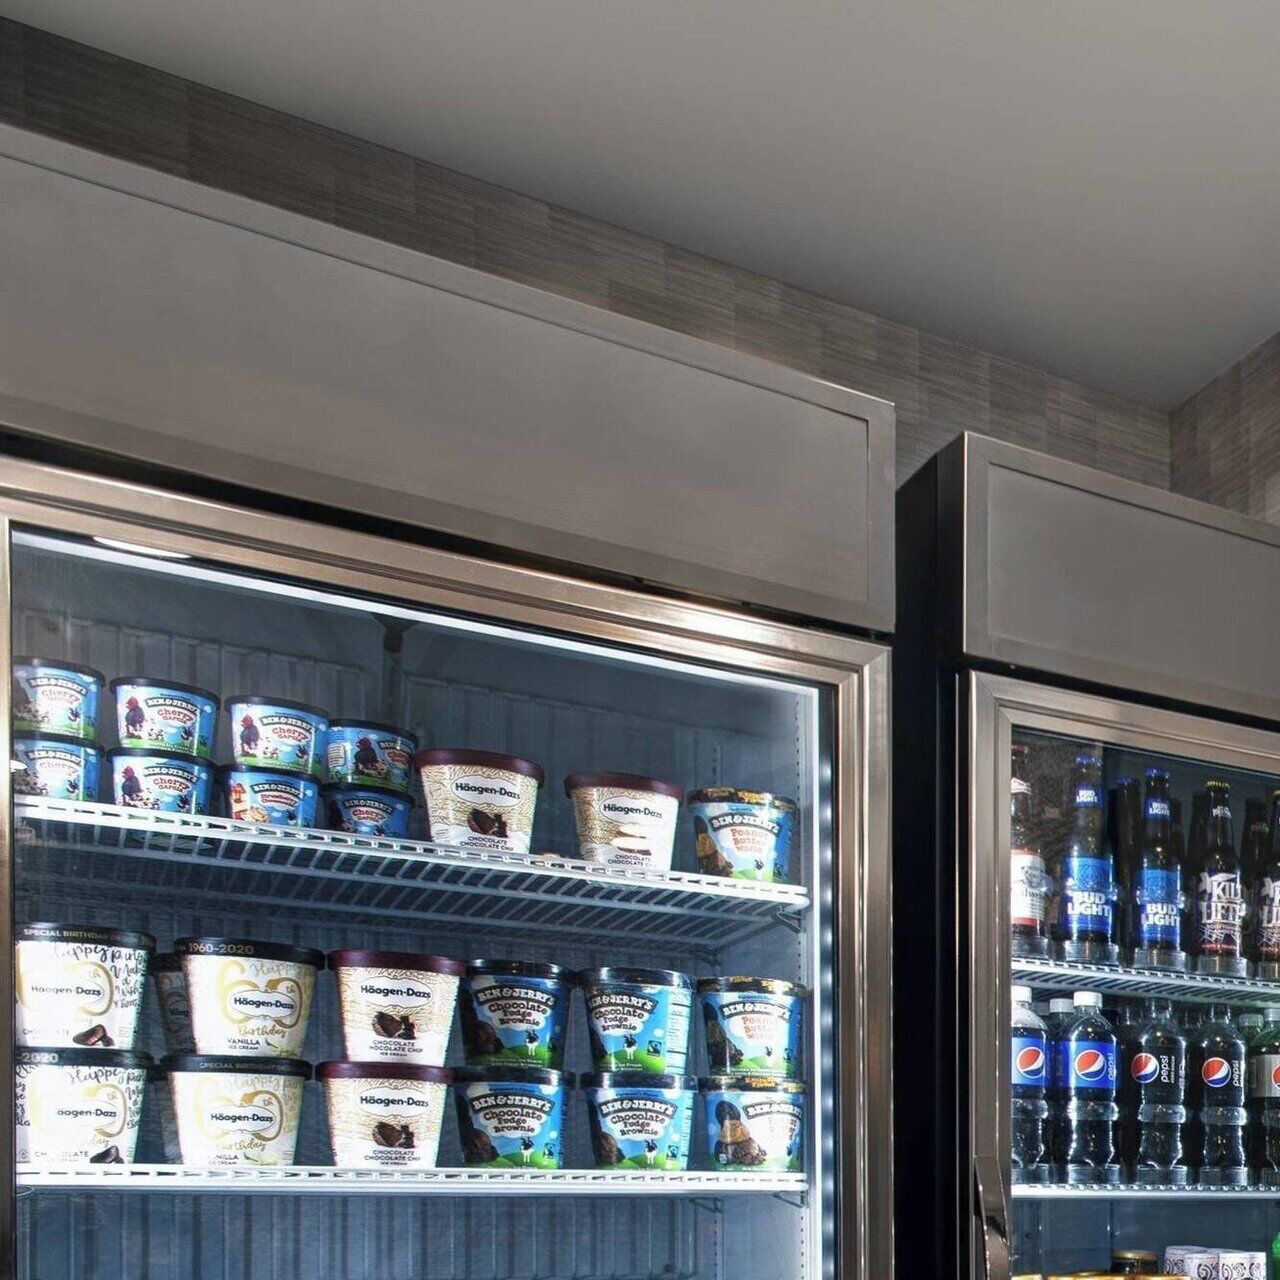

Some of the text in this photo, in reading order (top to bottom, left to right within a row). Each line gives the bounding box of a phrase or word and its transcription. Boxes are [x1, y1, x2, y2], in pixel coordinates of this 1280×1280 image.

[1071, 891, 1106, 904] BUD
[1067, 902, 1112, 917] LIGHT
[1146, 903, 1177, 915] BUD
[1141, 913, 1180, 926] LIGHT
[188, 943, 254, 955] 1960-2020
[361, 985, 431, 999] Häagen-Dazs
[234, 997, 294, 1009] Häagen-Dazs
[489, 1000, 548, 1015] Chocolate
[503, 1009, 533, 1018] Fudge
[594, 1006, 645, 1020] Chocolate
[499, 1016, 540, 1028] Brownie
[604, 1015, 628, 1024] Fudge
[602, 1022, 637, 1032] Brownie
[1160, 1055, 1169, 1083] pepsi
[1232, 1060, 1241, 1087] pepsi
[360, 1095, 429, 1107] Häagen-Dazs
[483, 1109, 543, 1124] Chocolate
[498, 1118, 526, 1127] Fudge
[611, 1112, 666, 1126] Chocolate
[493, 1125, 535, 1138] Brownie
[623, 1121, 651, 1130] Fudge
[620, 1127, 659, 1139] Brownie
